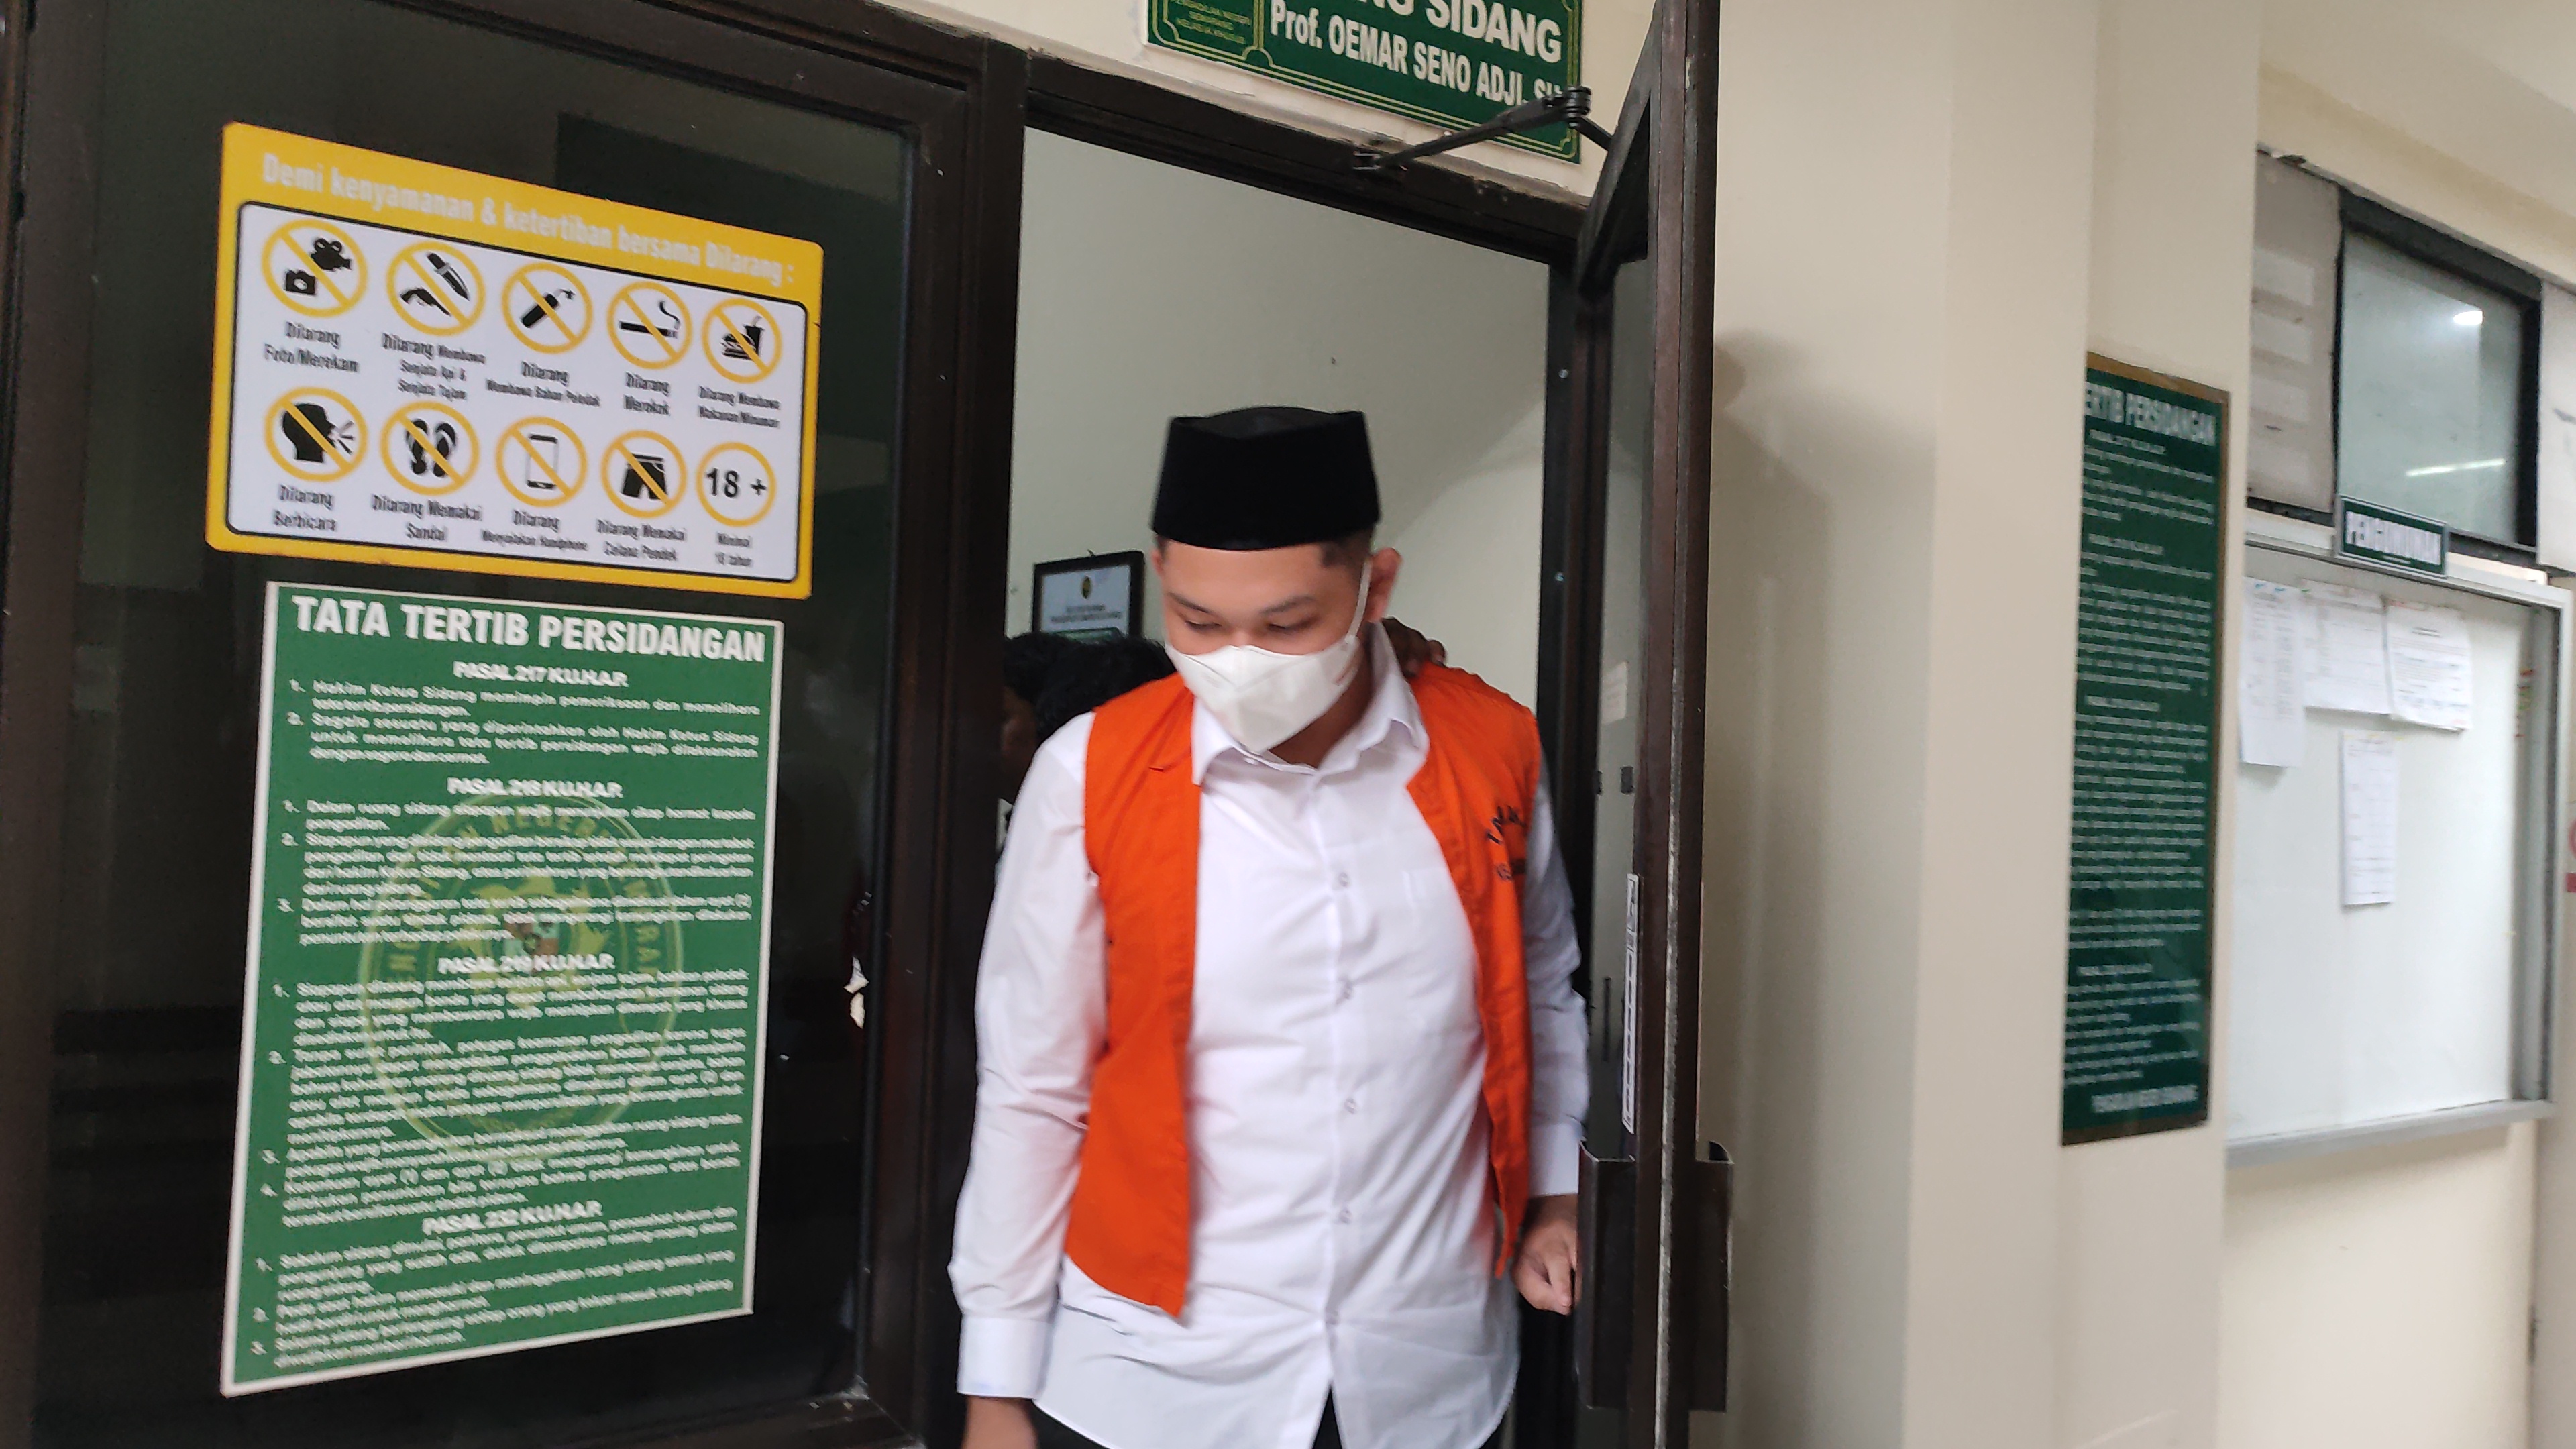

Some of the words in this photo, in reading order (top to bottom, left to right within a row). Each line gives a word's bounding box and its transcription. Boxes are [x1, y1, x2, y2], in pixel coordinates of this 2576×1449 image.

[1270, 0, 1323, 49] Prof.
[1328, 14, 1407, 75] OEMAR
[1413, 40, 1472, 93] SENO
[1426, 0, 1562, 64] SIDANG
[263, 152, 323, 192] Demi
[331, 166, 474, 221] kenyamanan
[480, 197, 497, 226] &
[504, 201, 612, 249] ketertiban
[706, 467, 740, 498] 18
[291, 594, 391, 638] TATA
[401, 604, 530, 647] TERTIB
[539, 613, 766, 662] PERSIDANGAN
